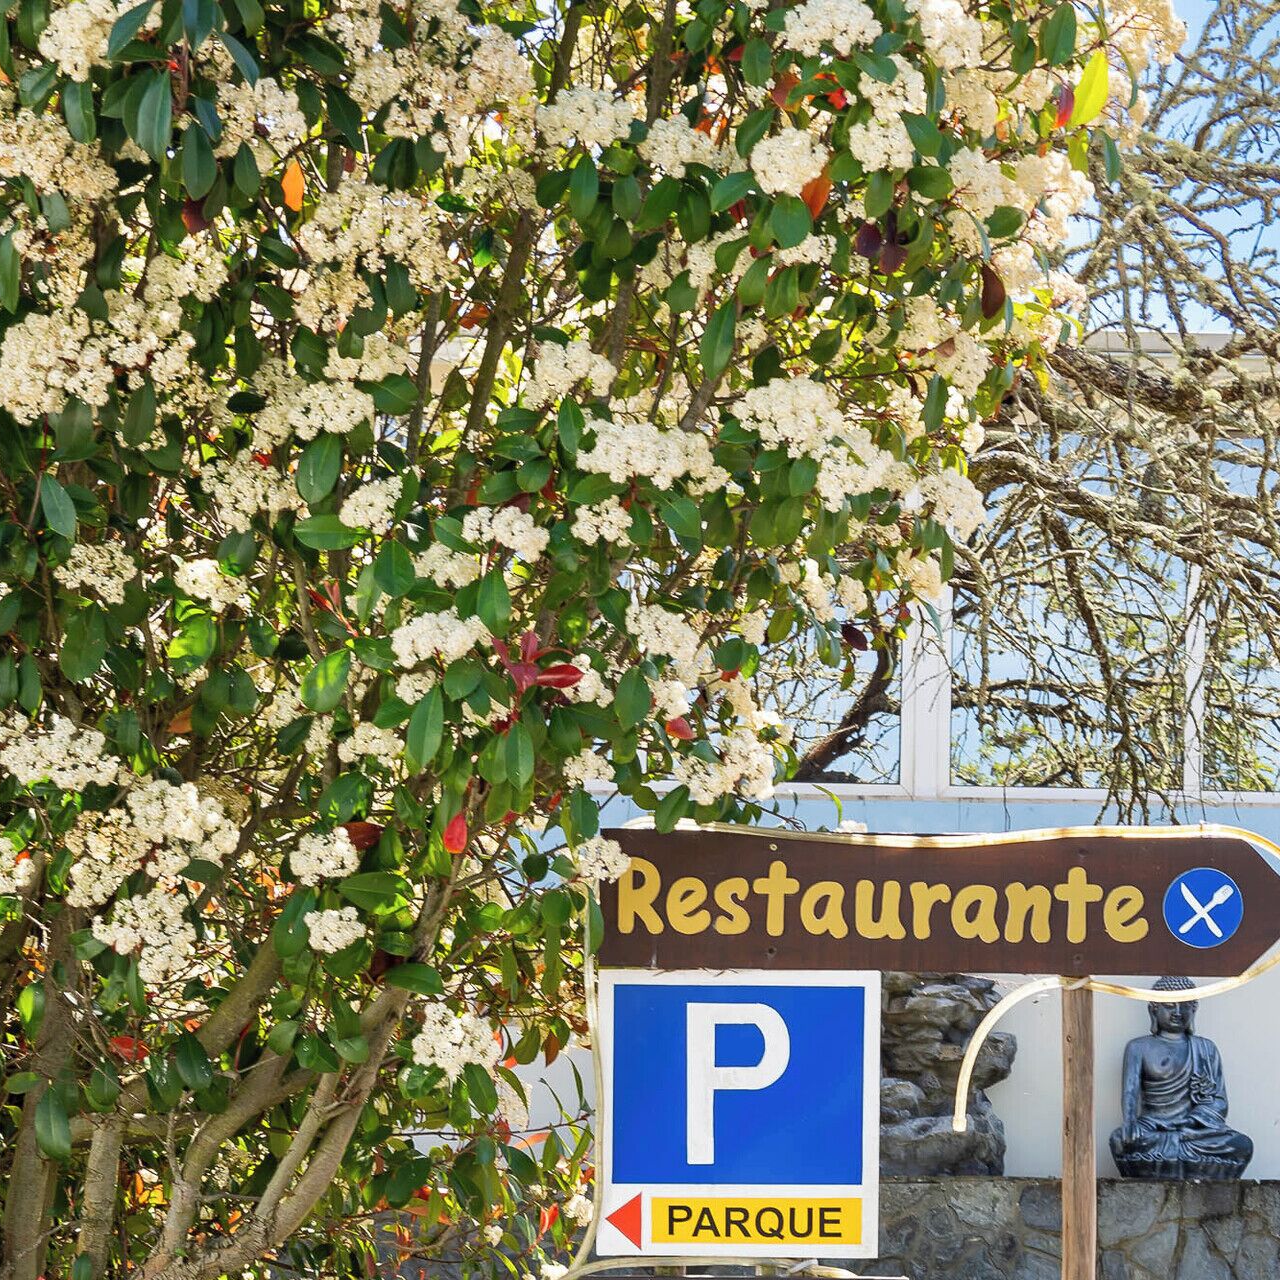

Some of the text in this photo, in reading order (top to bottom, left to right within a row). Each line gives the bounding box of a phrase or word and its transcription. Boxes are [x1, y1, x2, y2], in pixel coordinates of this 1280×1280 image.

[616, 856, 1150, 944] Restaurante
[686, 1002, 791, 1165] P
[667, 1205, 842, 1239] PARQUE
